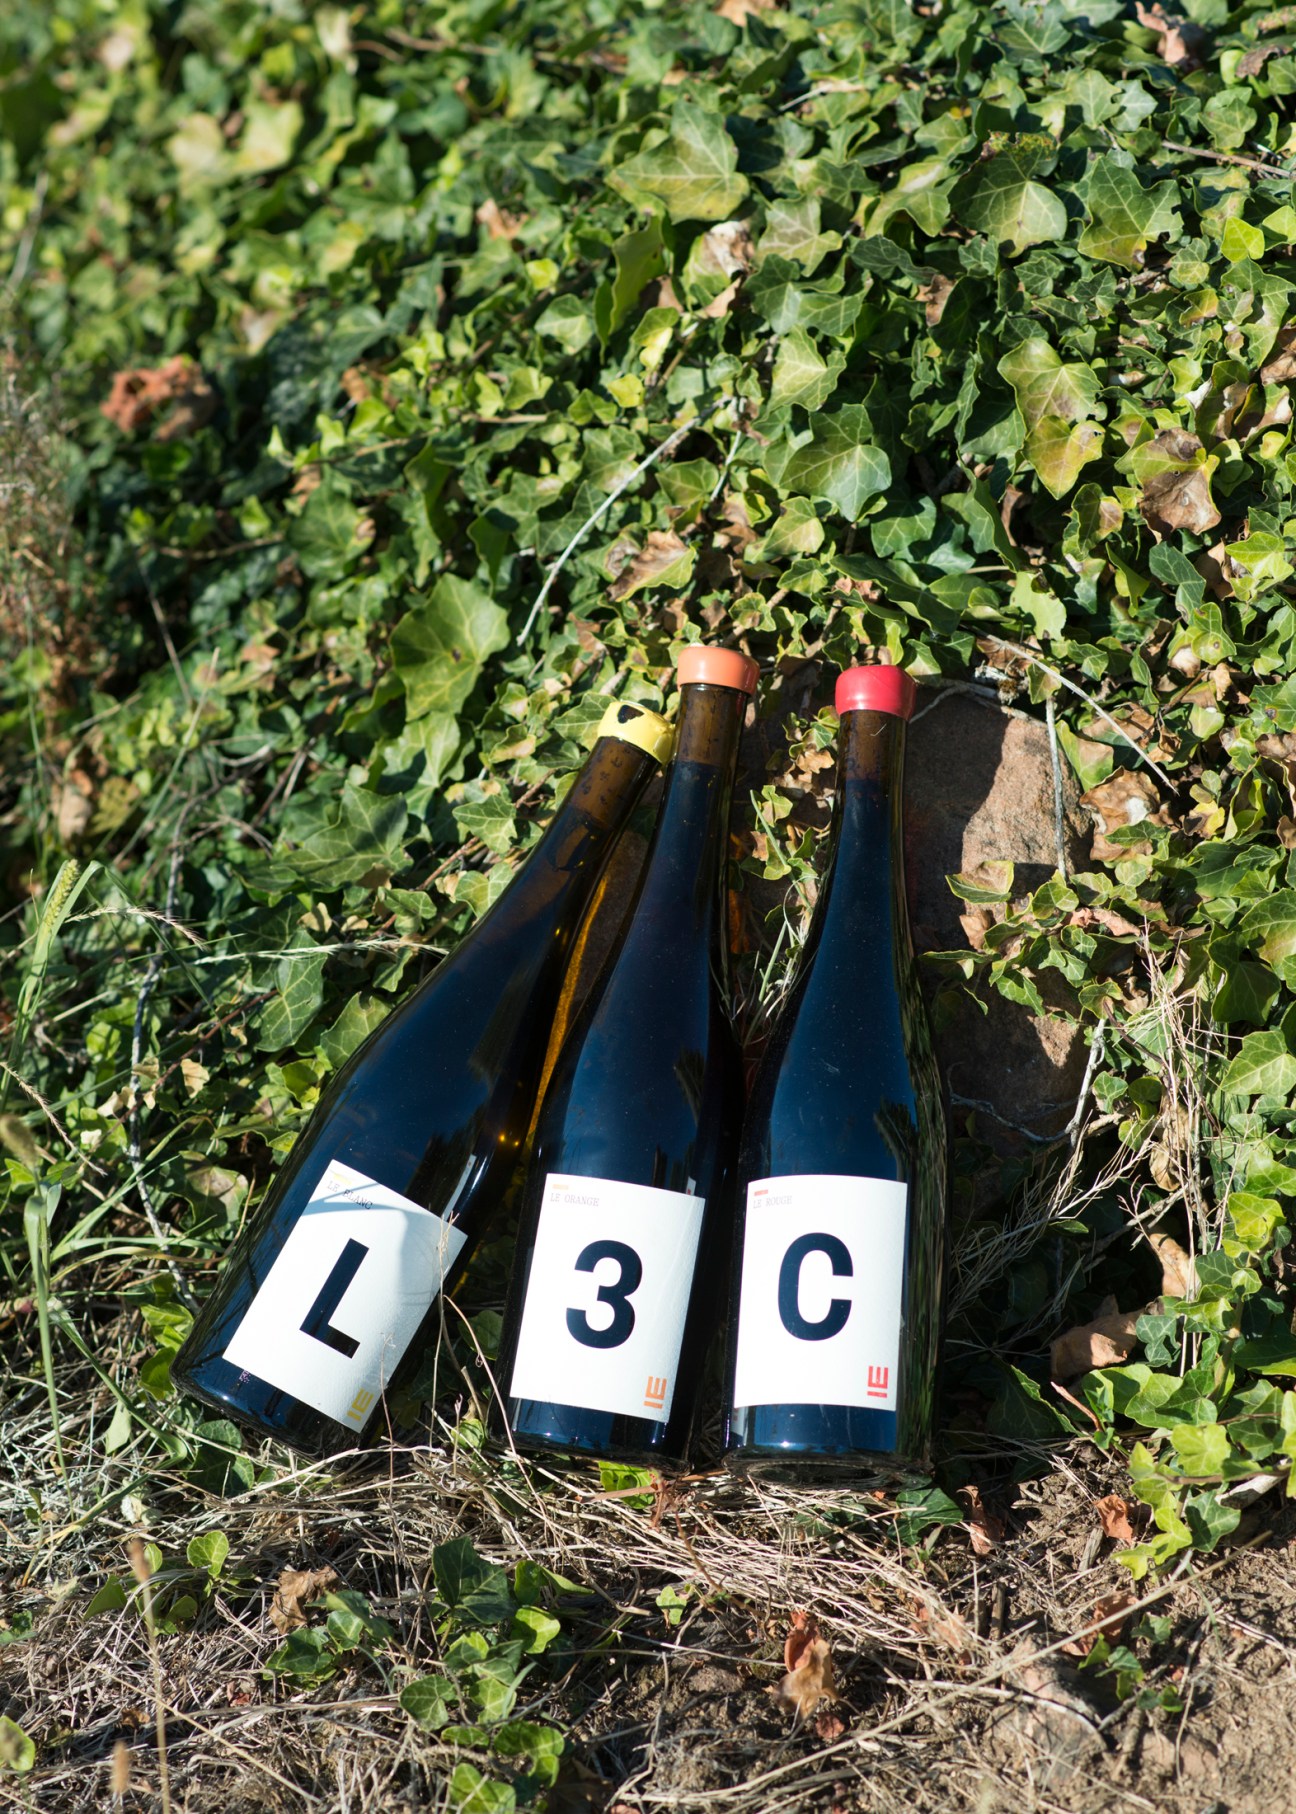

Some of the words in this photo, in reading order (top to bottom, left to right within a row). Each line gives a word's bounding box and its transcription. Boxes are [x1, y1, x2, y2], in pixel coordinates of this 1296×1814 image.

[327, 1180, 341, 1192] LE
[342, 1188, 374, 1210] BLANC
[549, 1192, 561, 1202] LE
[563, 1194, 600, 1207] ORANGE
[752, 1198, 762, 1210] LE
[299, 1237, 369, 1359] L
[565, 1239, 643, 1349] 3
[777, 1232, 854, 1341] C
